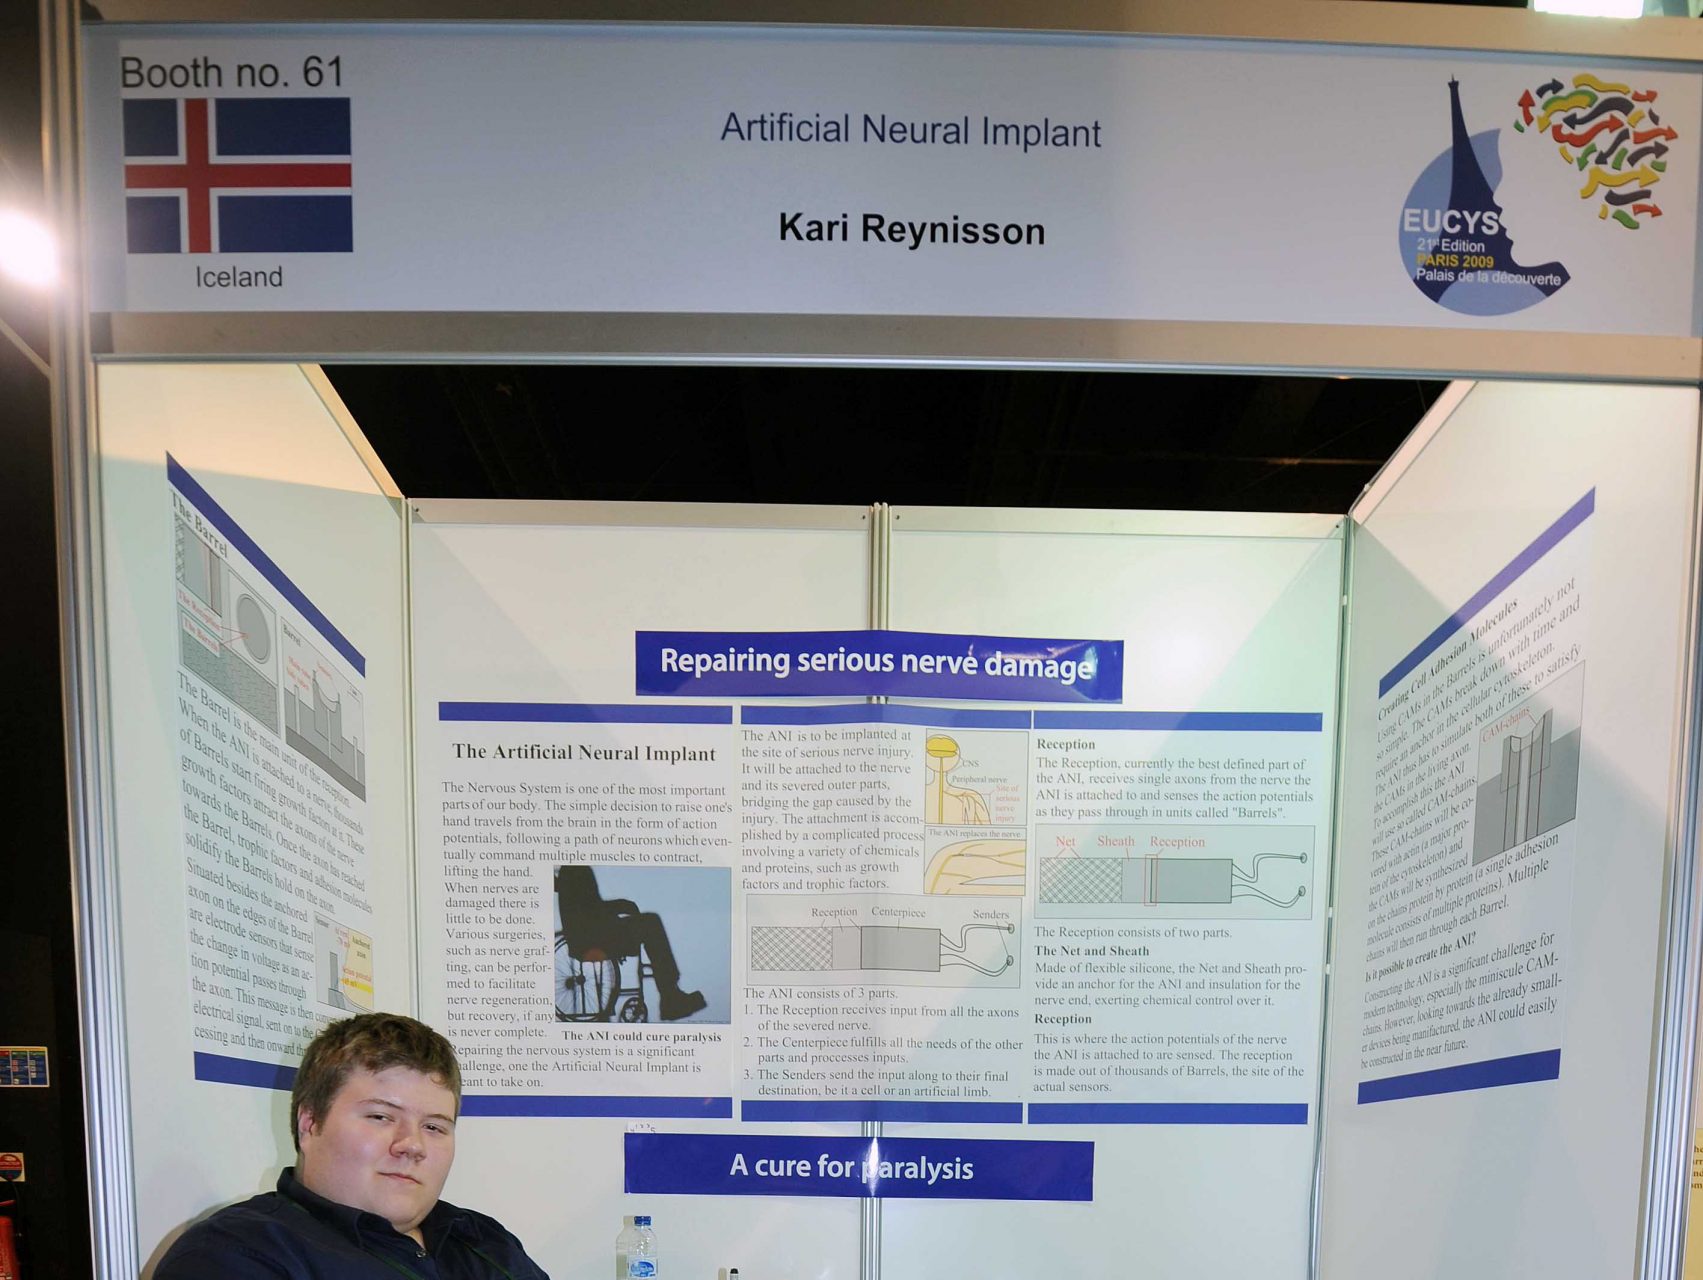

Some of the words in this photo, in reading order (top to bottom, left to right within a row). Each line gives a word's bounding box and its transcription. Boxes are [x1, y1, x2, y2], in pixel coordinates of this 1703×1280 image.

[120, 56, 223, 89] Booth
[237, 64, 289, 88] no.
[303, 55, 341, 87] 61
[721, 111, 849, 143] Artificial
[863, 114, 969, 145] Neural
[983, 116, 1102, 153] Implant
[1403, 208, 1500, 236] EUCYS
[780, 212, 848, 242] Kari
[862, 213, 1045, 251] Reynisson
[1417, 237, 1439, 251] 21st
[1441, 238, 1485, 253] Edition
[1417, 254, 1459, 267] PARIS
[1463, 255, 1494, 268] 2009
[196, 265, 283, 288] Iceland
[1416, 268, 1455, 282] Palais
[1458, 270, 1474, 283] de
[1477, 270, 1489, 283] la
[1492, 271, 1561, 286] découverte
[169, 488, 191, 522] The
[195, 514, 228, 558] Barrel
[660, 646, 790, 679] Repairing
[797, 646, 894, 673] serious
[901, 652, 978, 676] nerve
[984, 650, 1093, 686] damage
[1378, 687, 1410, 721] Creating
[1411, 672, 1427, 693] Cell
[1429, 641, 1467, 679] Adhesion
[1469, 599, 1518, 645] Molecules
[177, 671, 198, 698] The
[201, 688, 230, 723] Barrel
[233, 712, 241, 729] is
[244, 721, 257, 741] the
[259, 735, 280, 757] main
[281, 751, 297, 770] unit
[299, 763, 309, 777] of
[309, 768, 321, 785] the
[321, 779, 352, 809] reception.
[741, 730, 764, 741] The
[767, 730, 792, 741] ANI
[798, 730, 806, 741] is
[810, 732, 822, 741] to
[824, 729, 837, 741] be
[841, 728, 897, 743] implanted
[901, 731, 911, 741] at
[742, 746, 759, 757] the
[762, 746, 782, 758] site
[785, 746, 798, 758] of
[801, 746, 839, 758] serious
[843, 747, 874, 757] nerve
[878, 745, 913, 760] injury.
[1037, 738, 1095, 752] Reception
[452, 744, 486, 759] The
[493, 744, 572, 760] Artificial
[579, 745, 638, 760] Neural
[645, 746, 716, 765] Implant
[963, 759, 979, 768] CNS
[1036, 757, 1058, 768] The
[1061, 757, 1121, 772] Reception,
[1124, 758, 1174, 772] currently
[1178, 758, 1195, 769] the
[1198, 758, 1220, 770] best
[1223, 758, 1265, 770] defined
[1269, 760, 1290, 772] part
[1293, 759, 1307, 770] of
[951, 775, 986, 785] Peripheral
[988, 776, 1008, 784] nerve
[442, 782, 464, 793] The
[468, 782, 516, 794] Nervous
[519, 783, 561, 796] System
[565, 783, 574, 794] is
[578, 785, 598, 794] one
[602, 783, 616, 795] of
[618, 784, 635, 795] the
[639, 785, 666, 795] most
[670, 784, 726, 798] important
[442, 800, 470, 812] parts
[472, 799, 485, 810] of
[486, 801, 506, 810] our
[509, 799, 541, 813] body.
[544, 800, 566, 811] The
[570, 800, 607, 814] simple
[610, 800, 657, 812] decision
[661, 802, 672, 812] to
[675, 801, 702, 813] raise
[705, 802, 733, 813] one's
[930, 828, 942, 836] The
[944, 829, 958, 837] ANI
[960, 830, 987, 839] replaces
[989, 830, 1000, 838] the
[1056, 836, 1076, 847] Net
[1097, 836, 1135, 846] Sheath
[1150, 837, 1205, 849] Reception
[812, 907, 857, 919] Reception
[871, 906, 926, 919] Centerpiece
[973, 910, 1009, 919] Senders
[446, 929, 490, 939] Various
[493, 929, 546, 942] surgeries,
[1034, 926, 1055, 937] The
[1059, 927, 1114, 940] Reception
[1118, 928, 1161, 938] consists
[1164, 927, 1177, 938] of
[1179, 928, 1199, 938] two
[1203, 929, 1232, 940] parts.
[1035, 946, 1057, 956] The
[1060, 946, 1080, 956] Net
[1084, 946, 1106, 956] and
[1109, 946, 1150, 956] Sheath
[1366, 971, 1371, 982] Is
[1372, 969, 1378, 980] it
[1378, 960, 1405, 981] possible
[1406, 958, 1414, 968] to
[1415, 948, 1438, 965] create
[1440, 942, 1452, 956] the
[1454, 931, 1476, 951] ANI?
[1364, 983, 1403, 1003] Constructing
[1404, 979, 1414, 990] the
[1416, 970, 1432, 986] ANI
[1434, 968, 1440, 980] is
[1442, 969, 1447, 979] a
[1448, 953, 1489, 978] significant
[1491, 939, 1537, 962] challenge
[1540, 932, 1555, 948] for
[743, 988, 765, 998] The
[769, 988, 793, 998] ANI
[796, 988, 840, 999] consists
[843, 987, 856, 998] of
[857, 987, 864, 998] 3
[868, 989, 898, 1001] parts.
[1035, 1014, 1092, 1026] Reception
[562, 1030, 583, 1040] The
[587, 1031, 609, 1041] ANI
[613, 1031, 642, 1041] could
[645, 1034, 669, 1042] cure
[673, 1032, 722, 1044] paralysis
[1033, 1081, 1065, 1092] actual
[1069, 1083, 1112, 1092] sensors.
[730, 1153, 748, 1176] A
[755, 1156, 812, 1178] cure
[818, 1153, 855, 1178] for
[861, 1155, 974, 1190] paralysis
